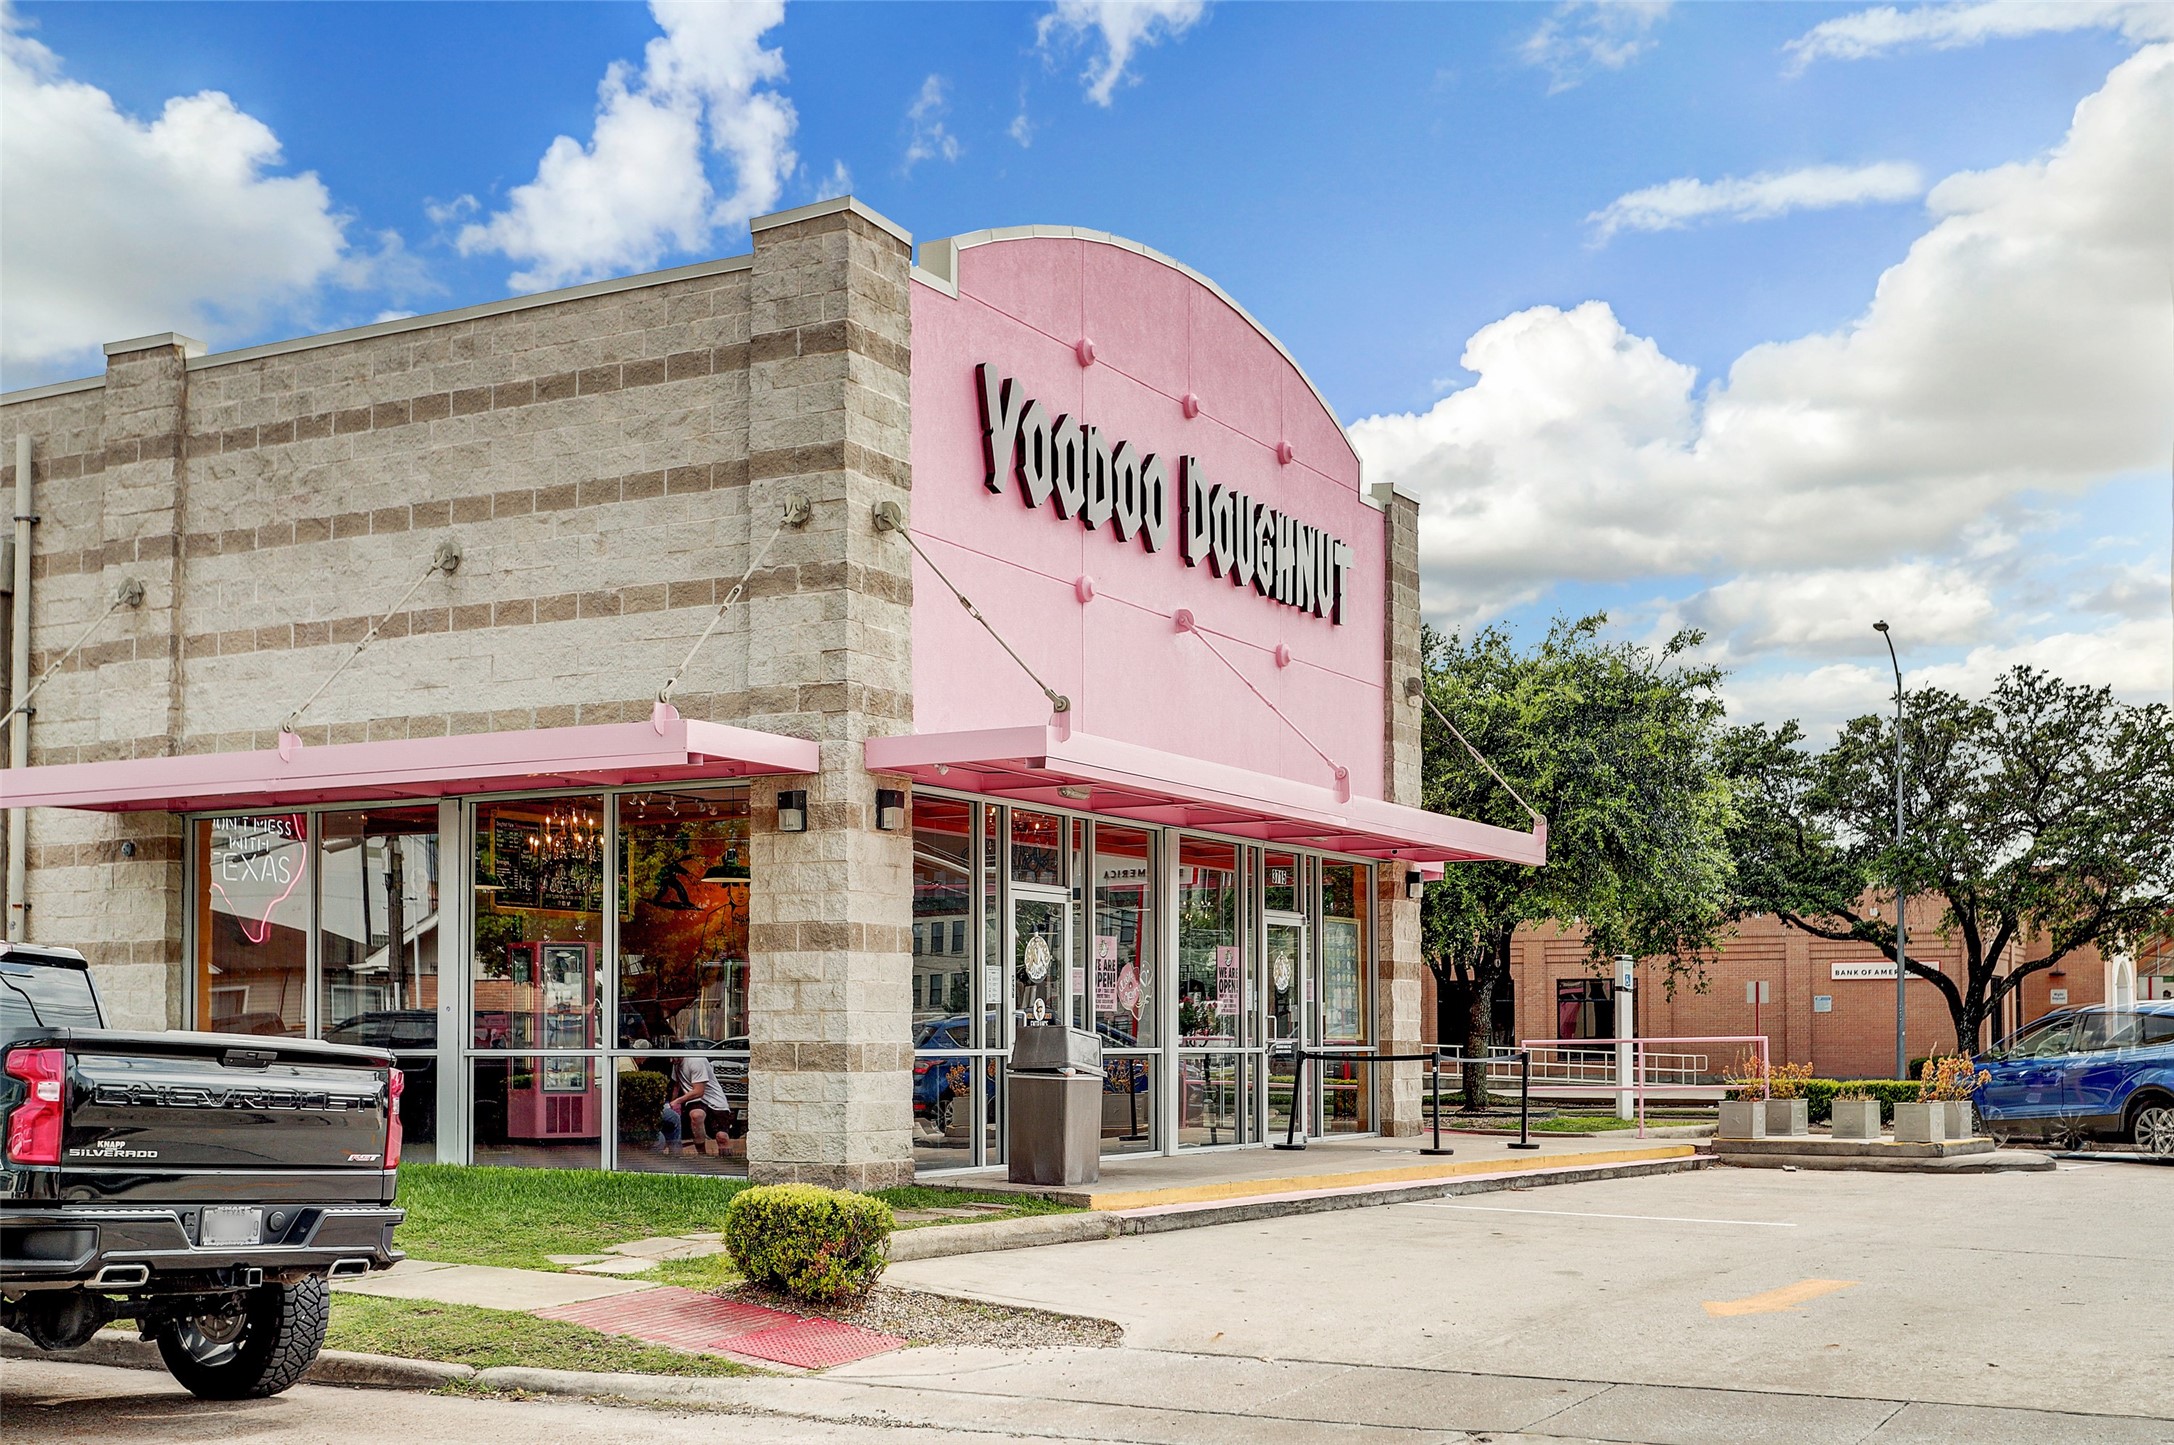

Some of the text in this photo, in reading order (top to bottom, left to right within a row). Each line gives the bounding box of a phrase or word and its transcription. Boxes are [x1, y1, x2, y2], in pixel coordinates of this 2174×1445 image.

[975, 362, 1354, 627] VOODOO DOUGHNUT
[253, 818, 292, 836] MESS
[229, 836, 269, 852] WITH
[1103, 959, 1116, 971] ARE
[1095, 972, 1116, 988] PEN!
[1219, 967, 1239, 979] WE ARE
[1218, 979, 1239, 993] OPEN!
[94, 1083, 378, 1113] CHEVROLET
[97, 1140, 126, 1149] KNAPP
[69, 1149, 158, 1158] SILVERADO
[347, 1154, 382, 1162] RST
